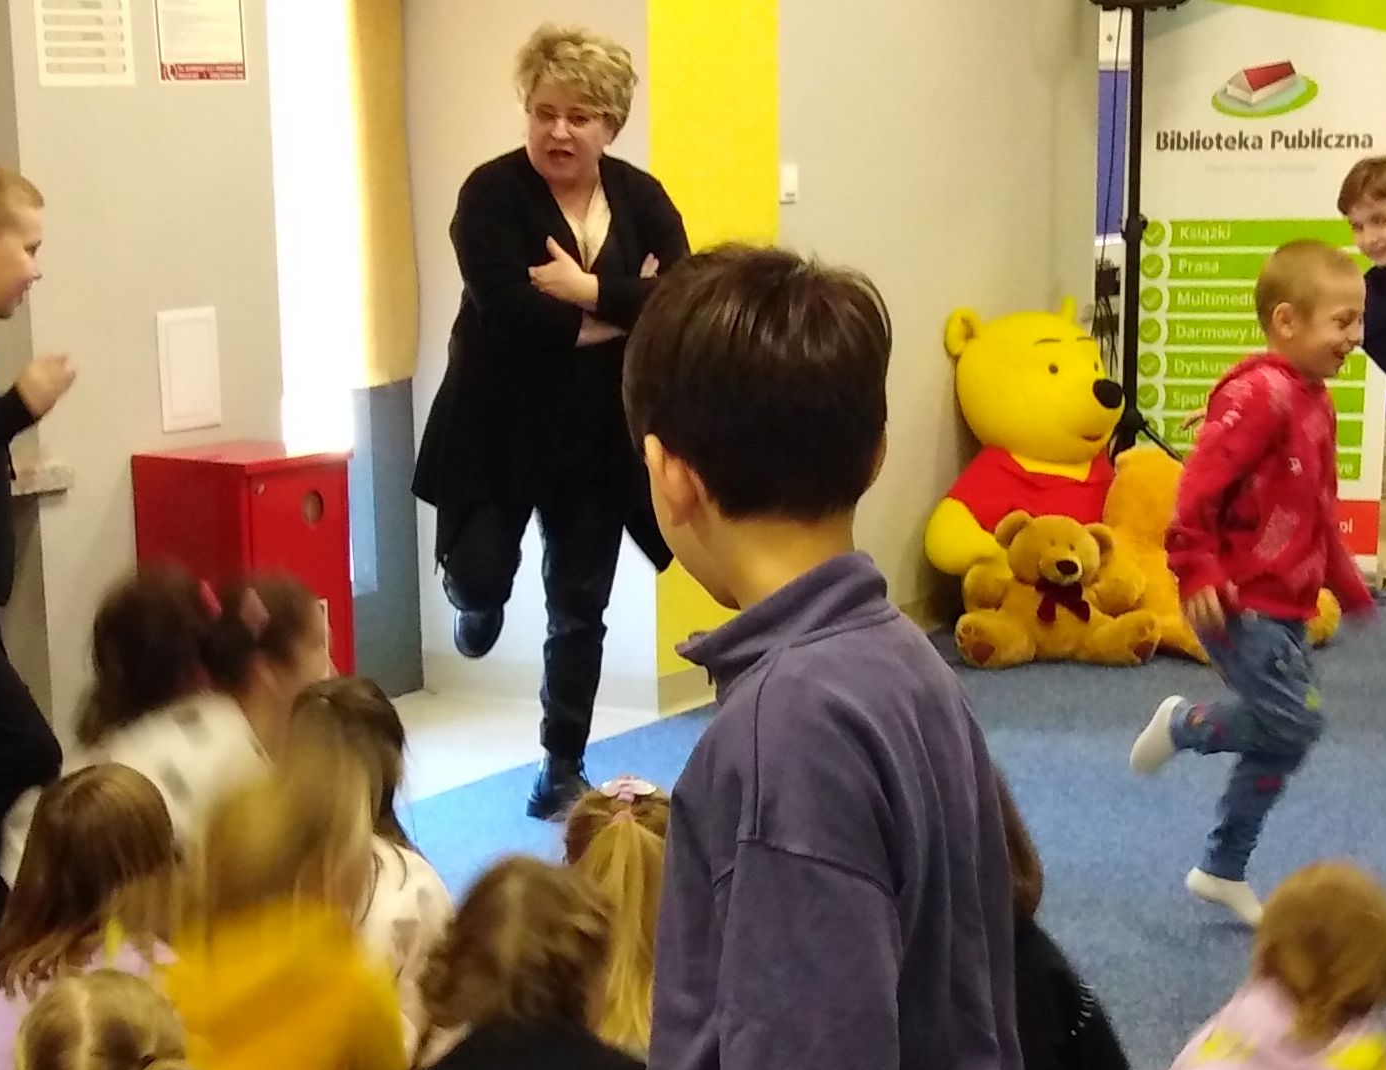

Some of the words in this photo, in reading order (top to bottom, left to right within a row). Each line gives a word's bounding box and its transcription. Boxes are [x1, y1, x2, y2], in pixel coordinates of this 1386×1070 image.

[1155, 128, 1263, 151] Biblioteka
[1270, 127, 1374, 149] Publiczna
[1178, 257, 1220, 273] Prasa
[1177, 290, 1254, 307] Multimedi
[1176, 324, 1248, 345] Darmowy
